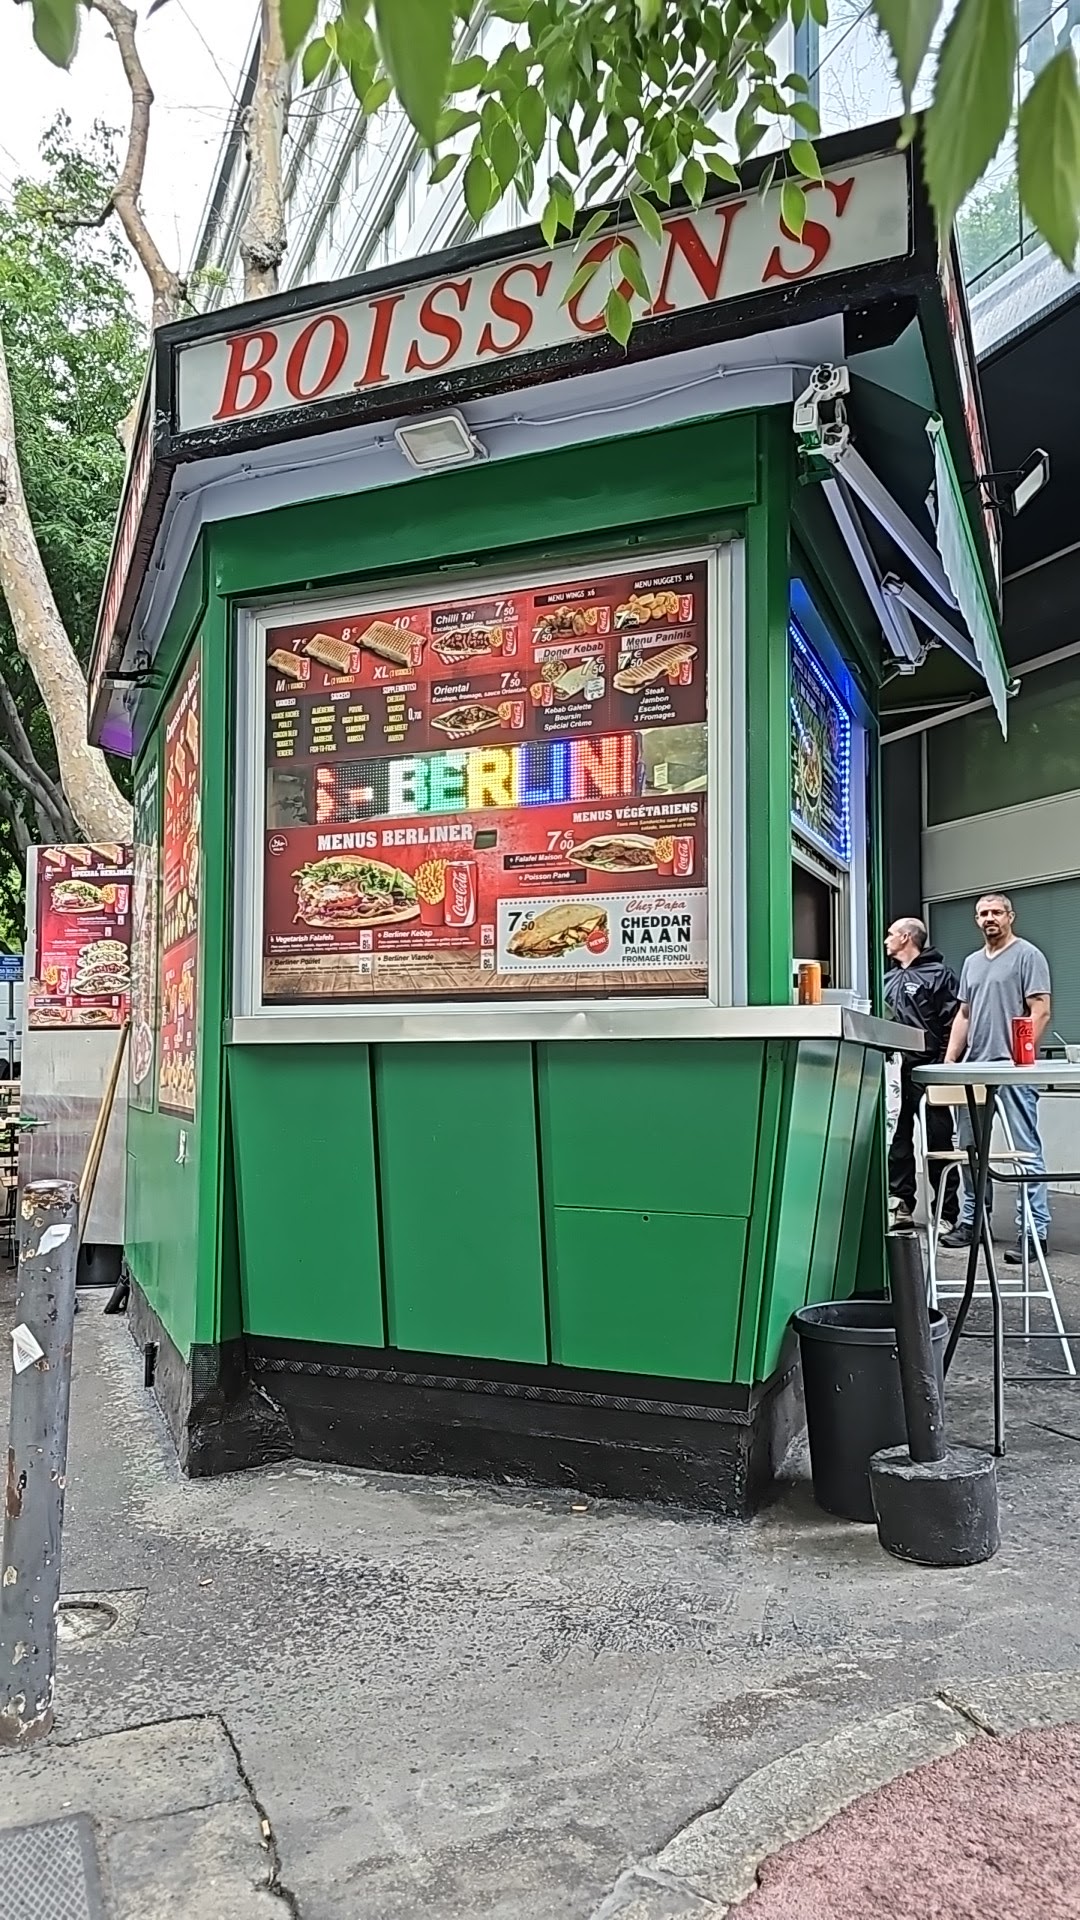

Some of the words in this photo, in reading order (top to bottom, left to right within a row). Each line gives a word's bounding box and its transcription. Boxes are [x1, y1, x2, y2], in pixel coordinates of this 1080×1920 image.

[211, 177, 856, 421] BOISSONS
[634, 580, 652, 589] MENU
[653, 575, 682, 586] NUGGETS
[547, 594, 564, 602] MENU
[566, 590, 585, 599] WINGS
[655, 630, 692, 643] Paninis
[543, 649, 572, 658] Doner
[573, 643, 604, 653] Kebab
[275, 679, 286, 692] M
[433, 683, 470, 695] Oriental
[640, 696, 669, 704] Jambon
[544, 706, 566, 715] Kebab
[567, 703, 592, 712] Galette
[638, 704, 671, 713] Escalope
[554, 713, 582, 722] Boursin
[640, 711, 676, 721] Fromages
[544, 722, 569, 732] Spécial
[388, 734, 632, 815] BERLIN
[573, 809, 613, 823] MENUS
[615, 802, 699, 819] VÉGÉTARIENS
[317, 831, 377, 851] MENUS
[382, 824, 474, 847] BERLINER
[538, 853, 563, 861] Maison
[524, 873, 552, 881] Poisson
[552, 871, 571, 879] Pané
[625, 899, 653, 914] Chez
[654, 898, 687, 912] Papa
[621, 914, 692, 929] CHEDDAR
[622, 927, 691, 944] NAAN
[625, 946, 647, 955] PAIN
[650, 944, 688, 953] MAISON
[663, 953, 691, 961] FONDU
